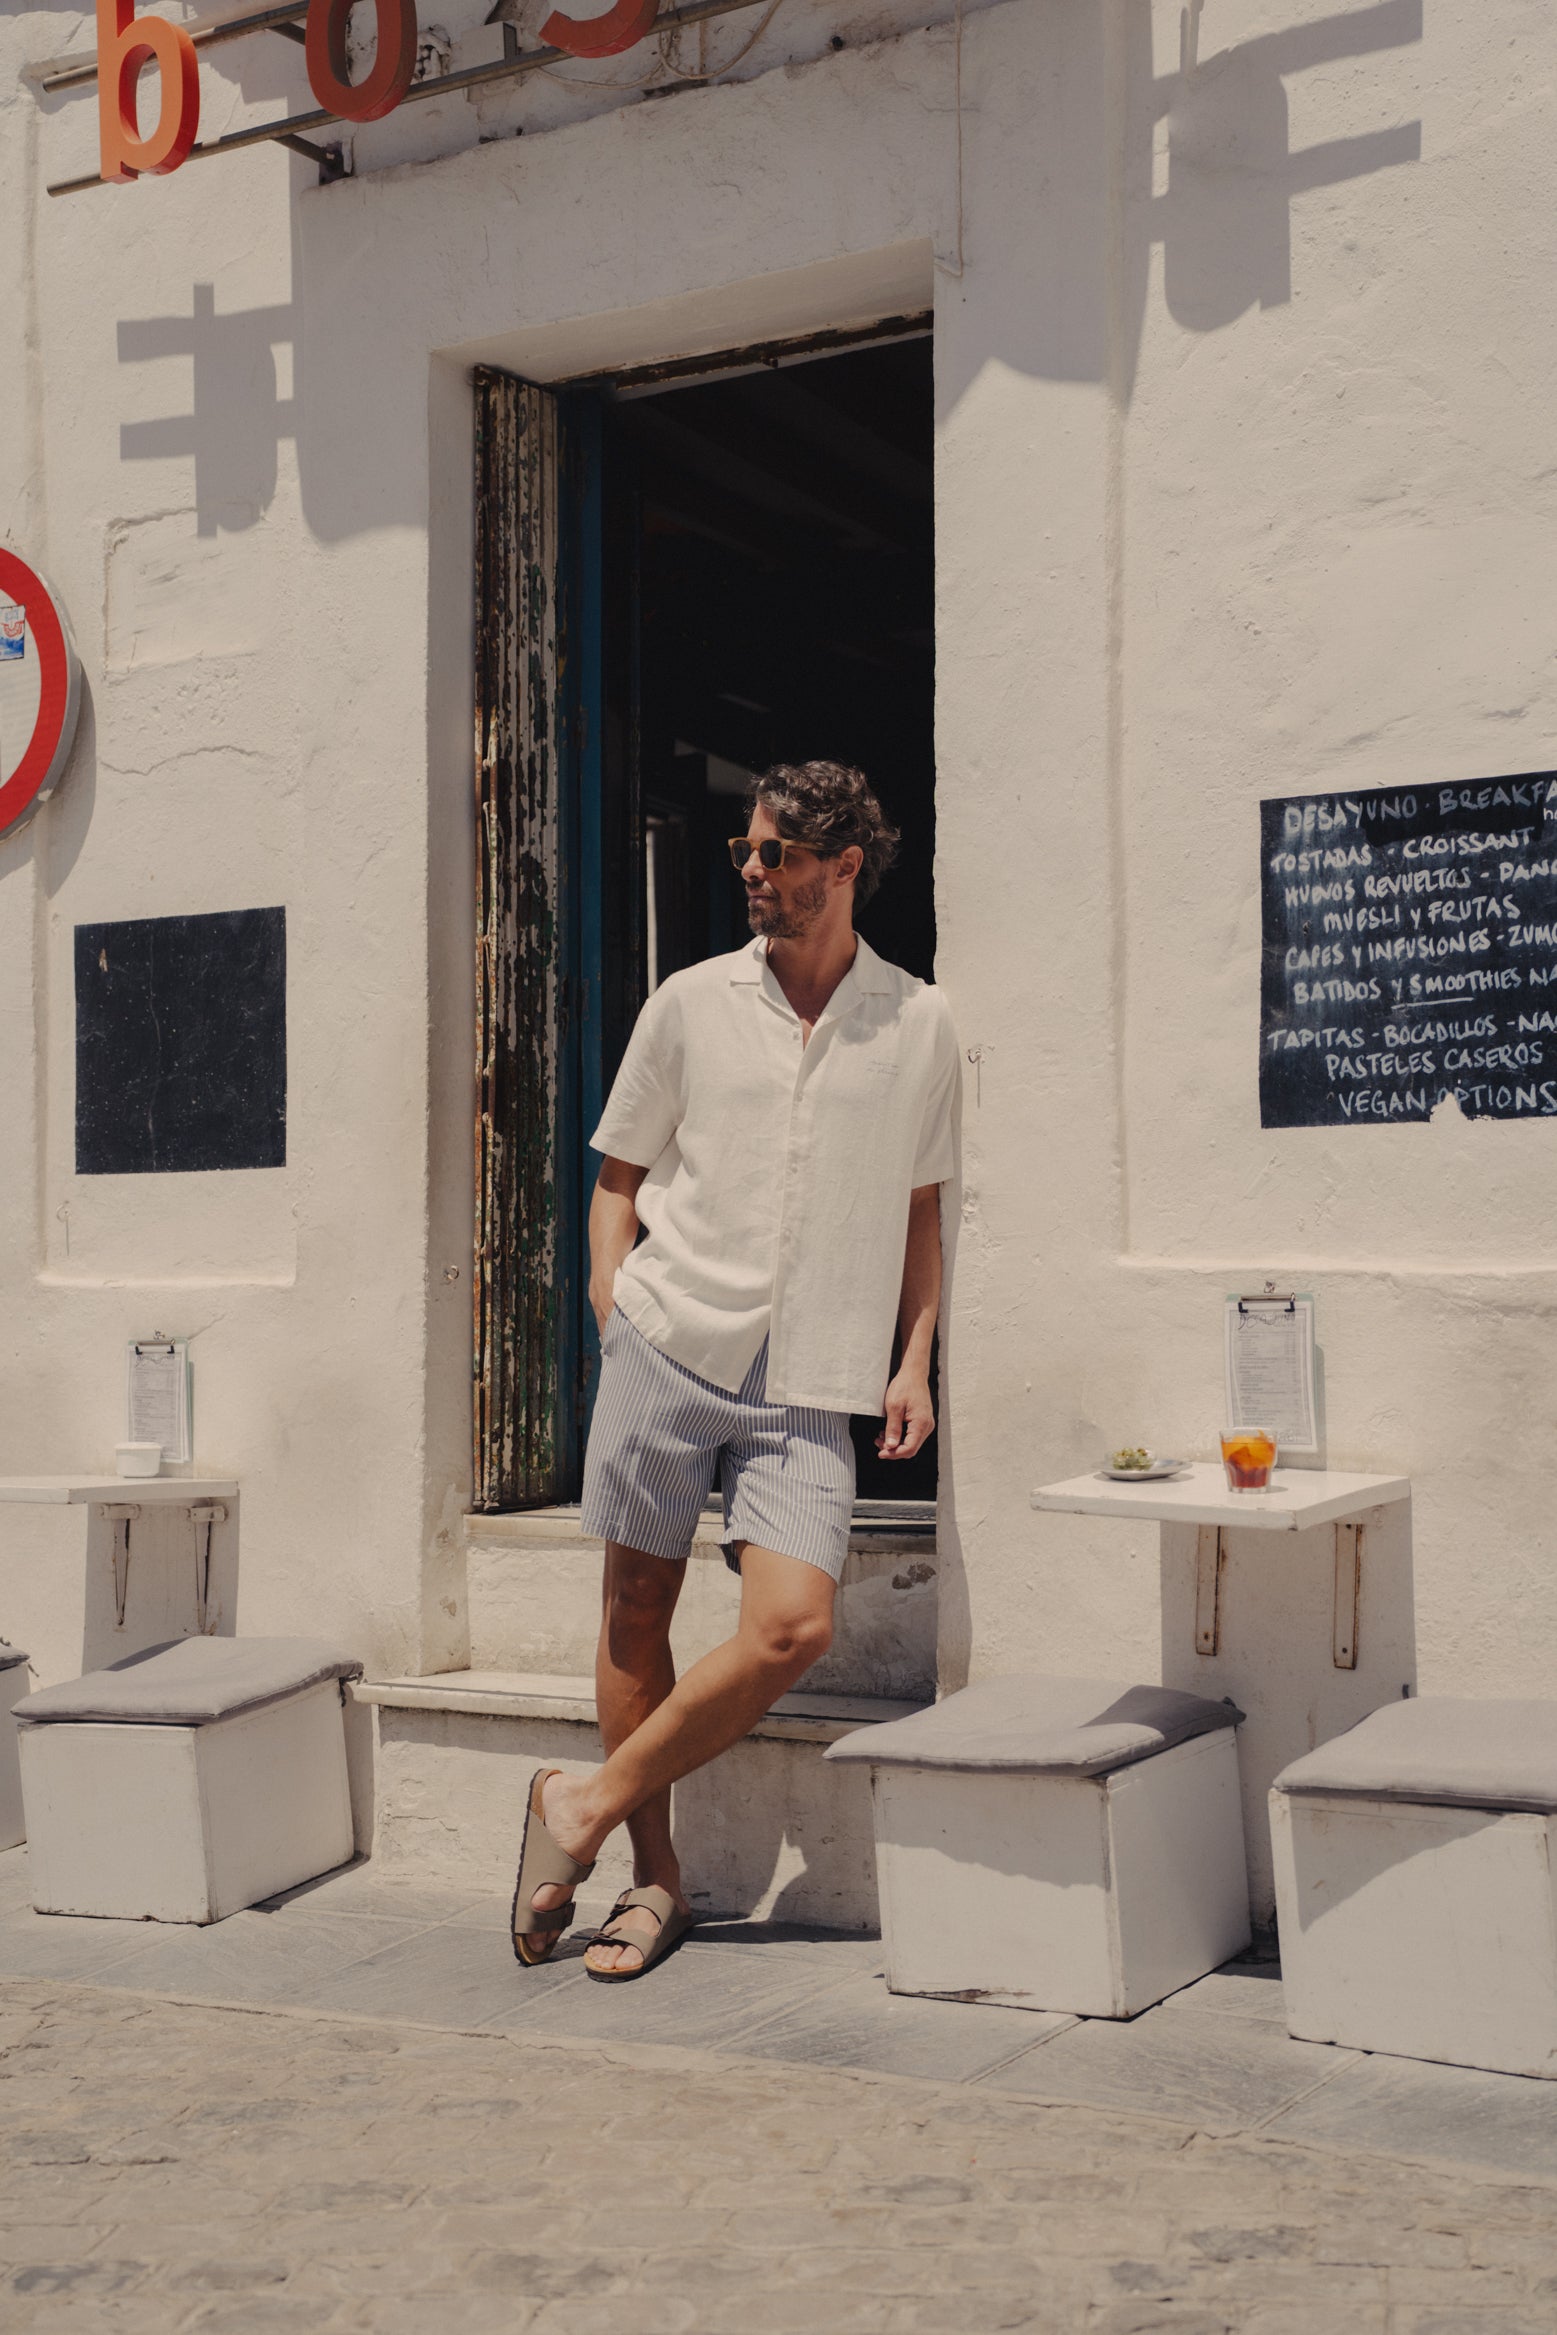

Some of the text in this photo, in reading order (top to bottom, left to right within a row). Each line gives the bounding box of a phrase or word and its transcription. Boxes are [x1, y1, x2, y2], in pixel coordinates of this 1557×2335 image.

[1284, 795, 1418, 833] DESAYUNO
[1270, 844, 1373, 874] TOSTADAS
[1402, 826, 1535, 859] CROISSANT
[1364, 866, 1472, 898] REVUELTOS
[1323, 904, 1400, 934] MUESLI
[1427, 893, 1521, 925] FRUTAS
[1368, 927, 1491, 963] INFUSIONES
[1293, 976, 1382, 1005] BATIDOS
[1409, 967, 1522, 996] SMOOTHIES
[1267, 1028, 1366, 1051] TAPITAS
[1383, 1014, 1499, 1048] BOCADILLOS
[1325, 1041, 1543, 1082] PASTELES CASEROS
[1338, 1087, 1427, 1117] VEGAN
